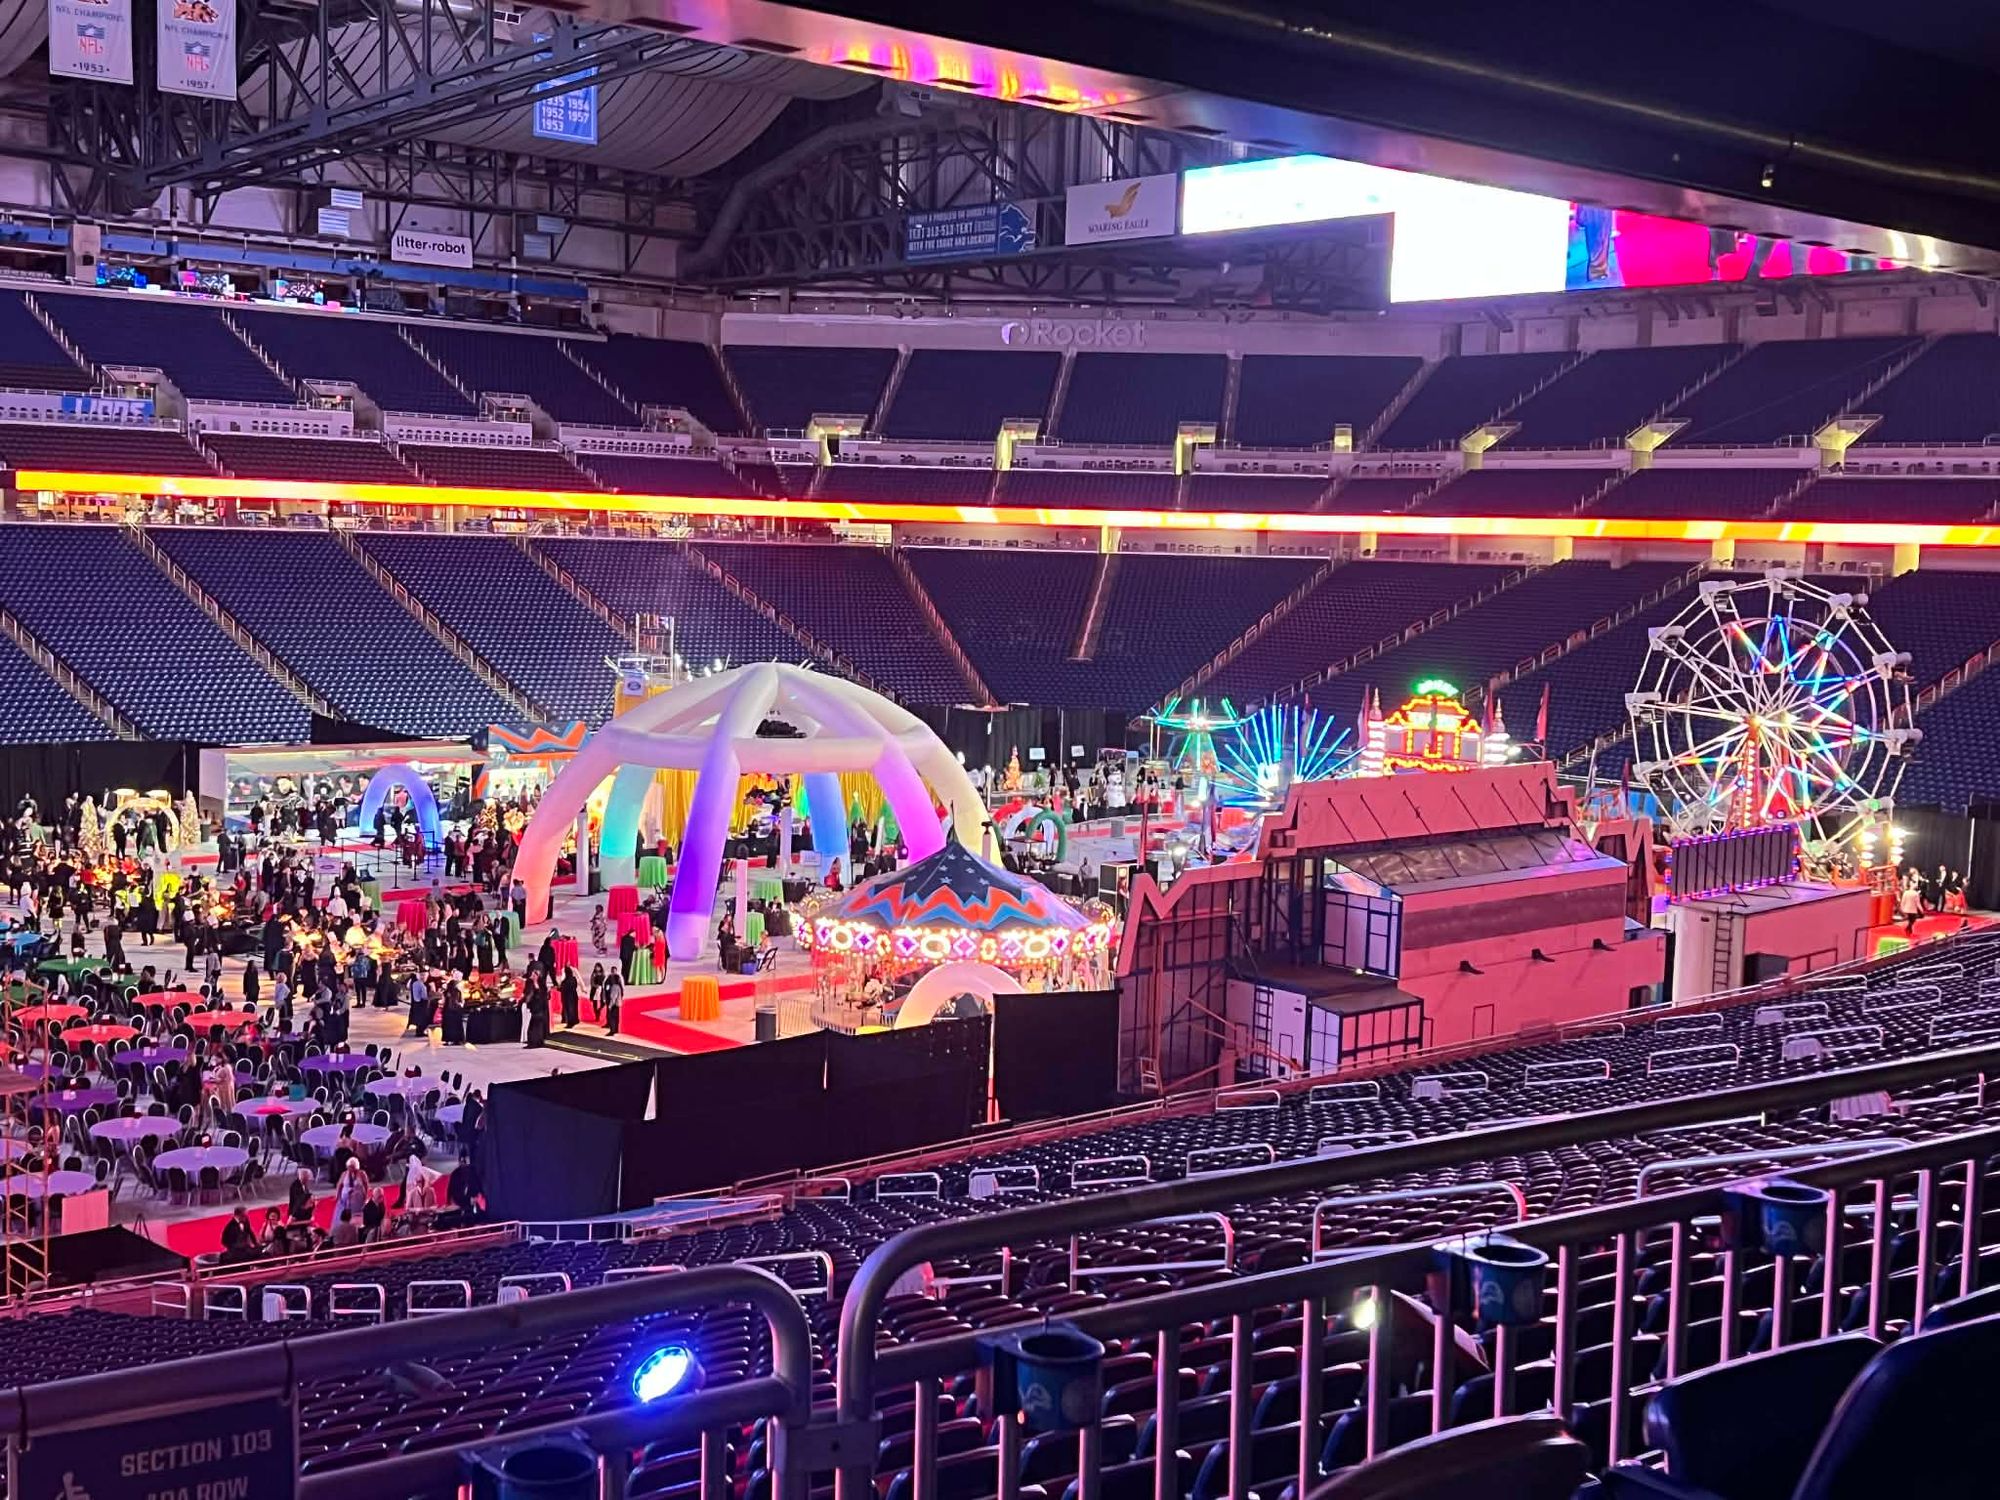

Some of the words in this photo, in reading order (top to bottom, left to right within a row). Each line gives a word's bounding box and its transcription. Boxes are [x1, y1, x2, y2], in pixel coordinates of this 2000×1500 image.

[79, 62, 104, 73] 1953
[186, 80, 209, 89] 1957
[568, 98, 590, 111] 1954
[542, 106, 564, 120] 1952
[568, 110, 590, 123] 1957
[542, 118, 564, 131] 1953
[1030, 319, 1146, 346] Rocket
[120, 1437, 222, 1477] SECTION
[231, 1429, 272, 1457] 103
[197, 1475, 248, 1500] ROW
